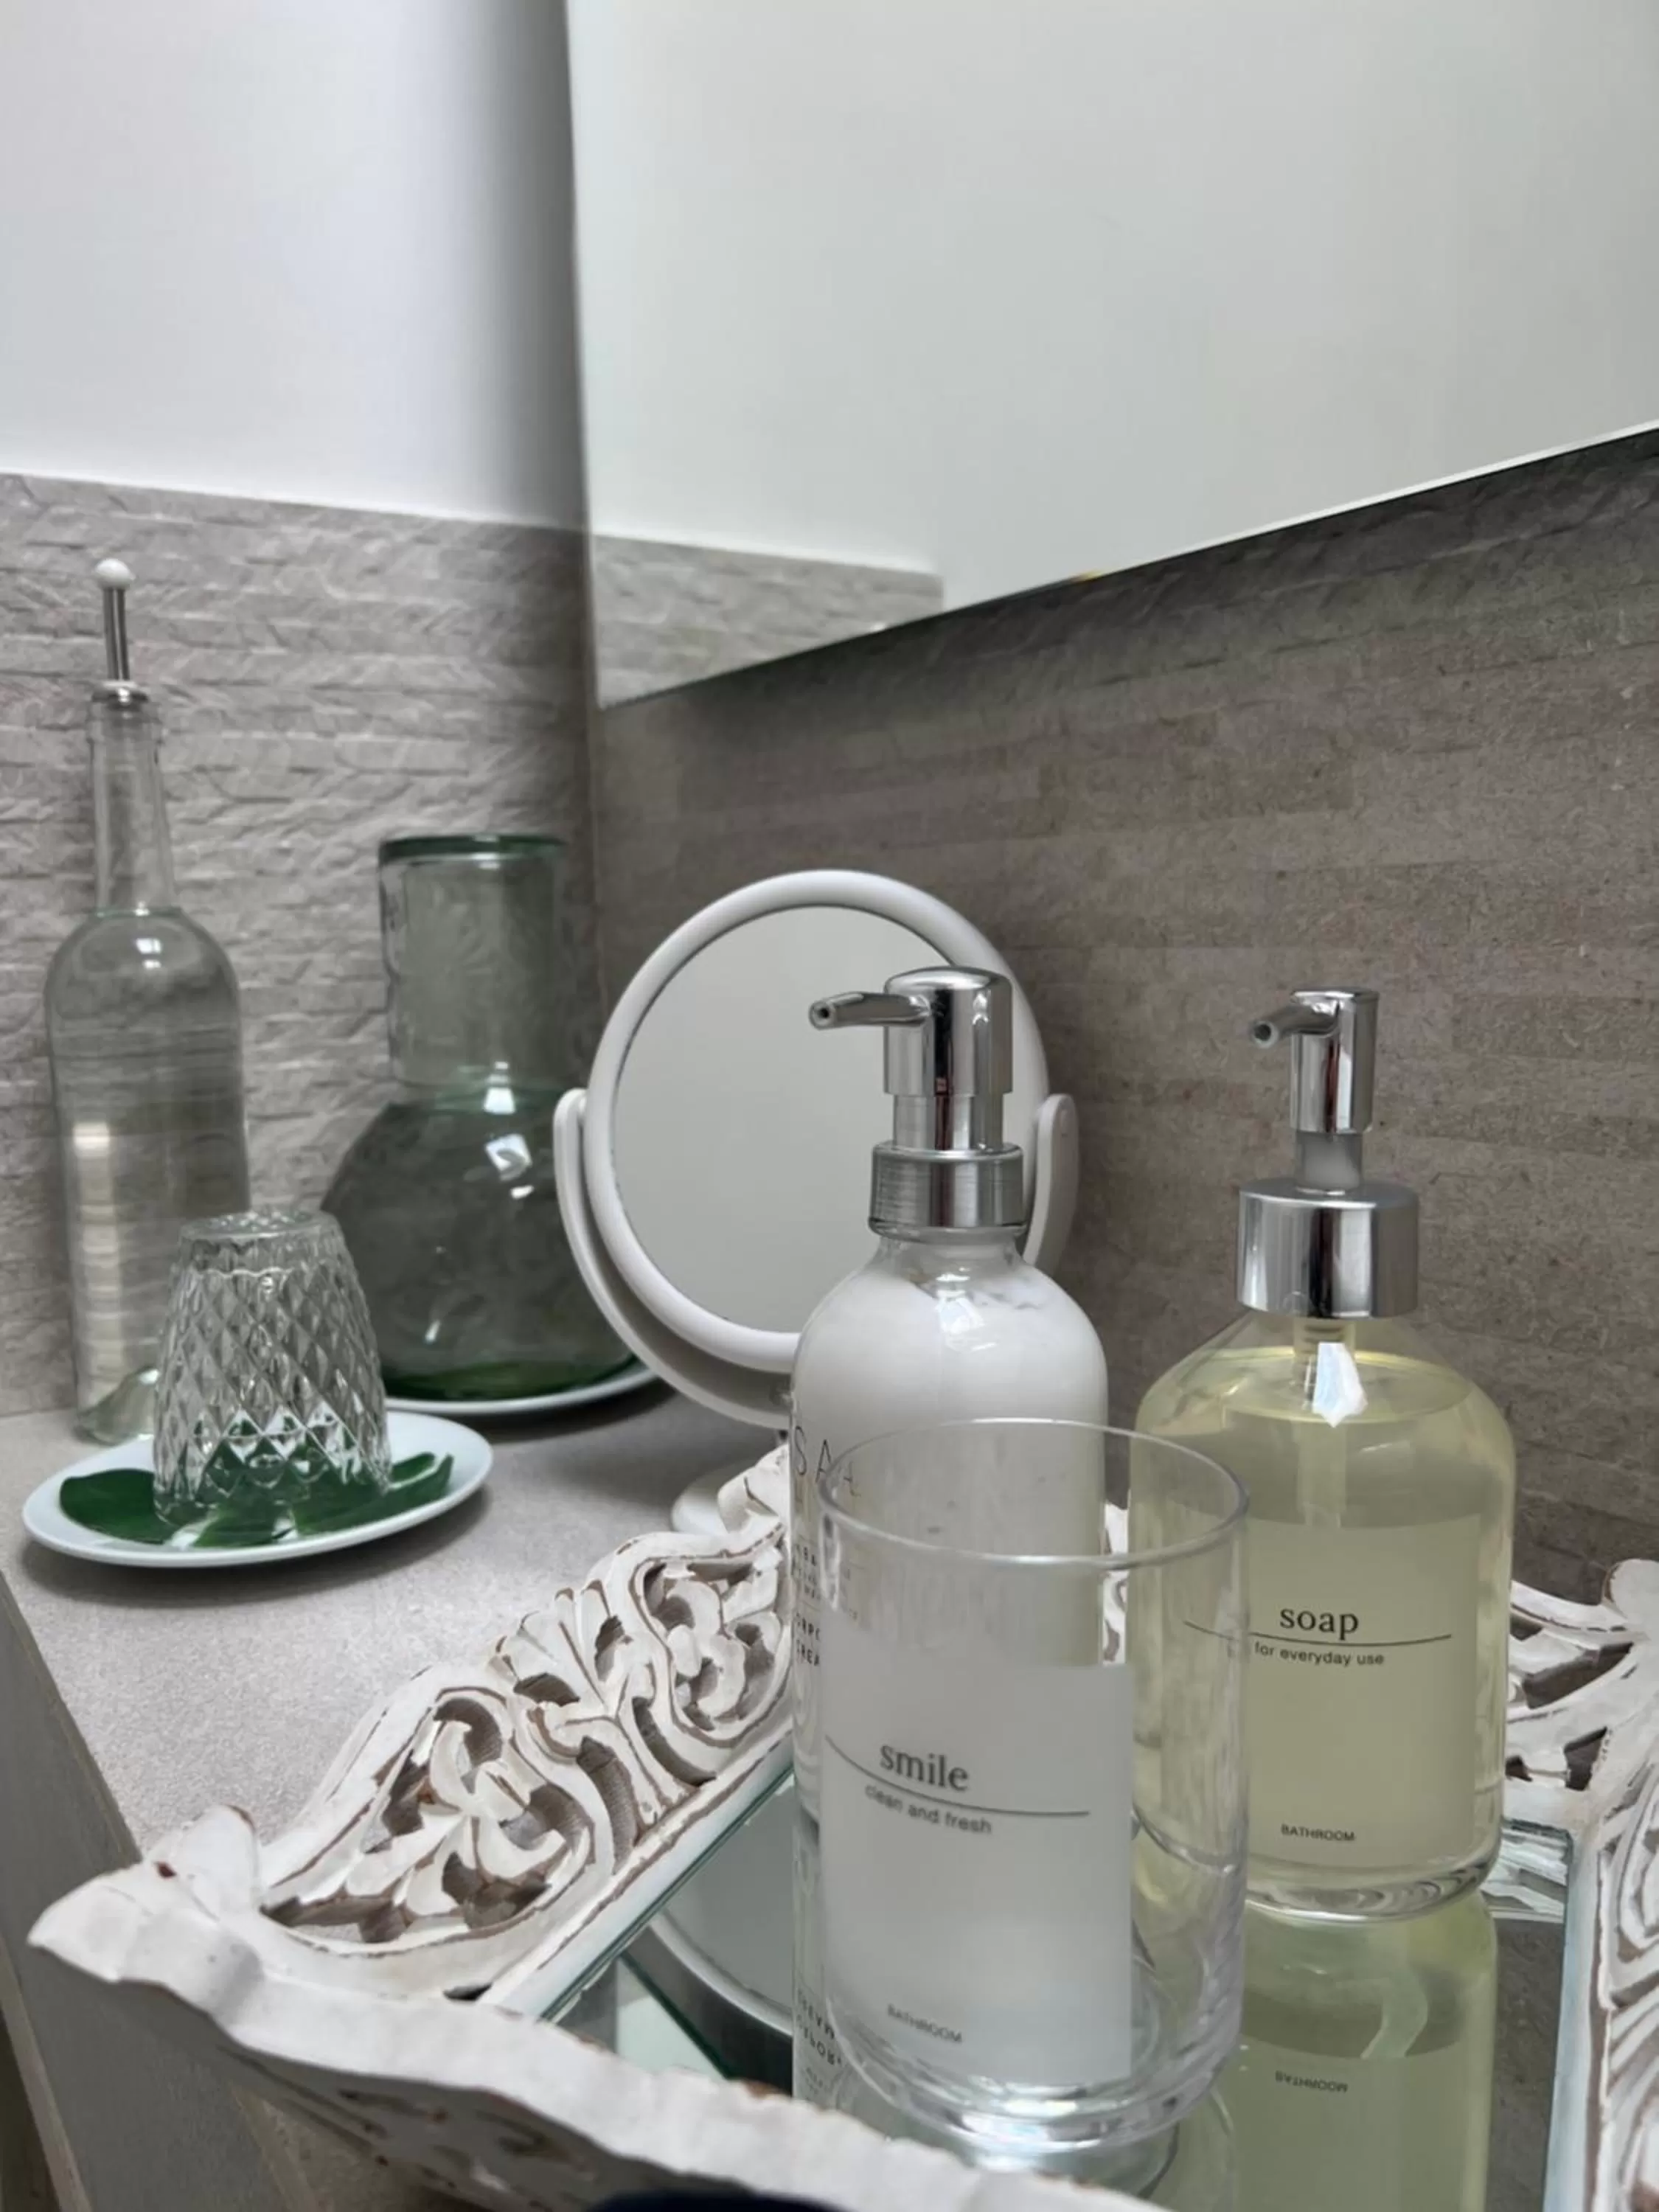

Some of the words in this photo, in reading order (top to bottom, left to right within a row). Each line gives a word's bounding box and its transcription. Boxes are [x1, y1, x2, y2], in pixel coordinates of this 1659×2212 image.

[1279, 1607, 1359, 1641] soap
[1254, 1641, 1274, 1657] for
[1279, 1649, 1352, 1666] everyday
[1357, 1653, 1385, 1666] use
[880, 1744, 970, 1792] smile
[864, 1783, 902, 1813] clean
[908, 1801, 939, 1824] and
[945, 1812, 992, 1834] fresh
[1280, 1823, 1355, 1841] BATHROOM
[887, 2003, 962, 2044] BATHROOM
